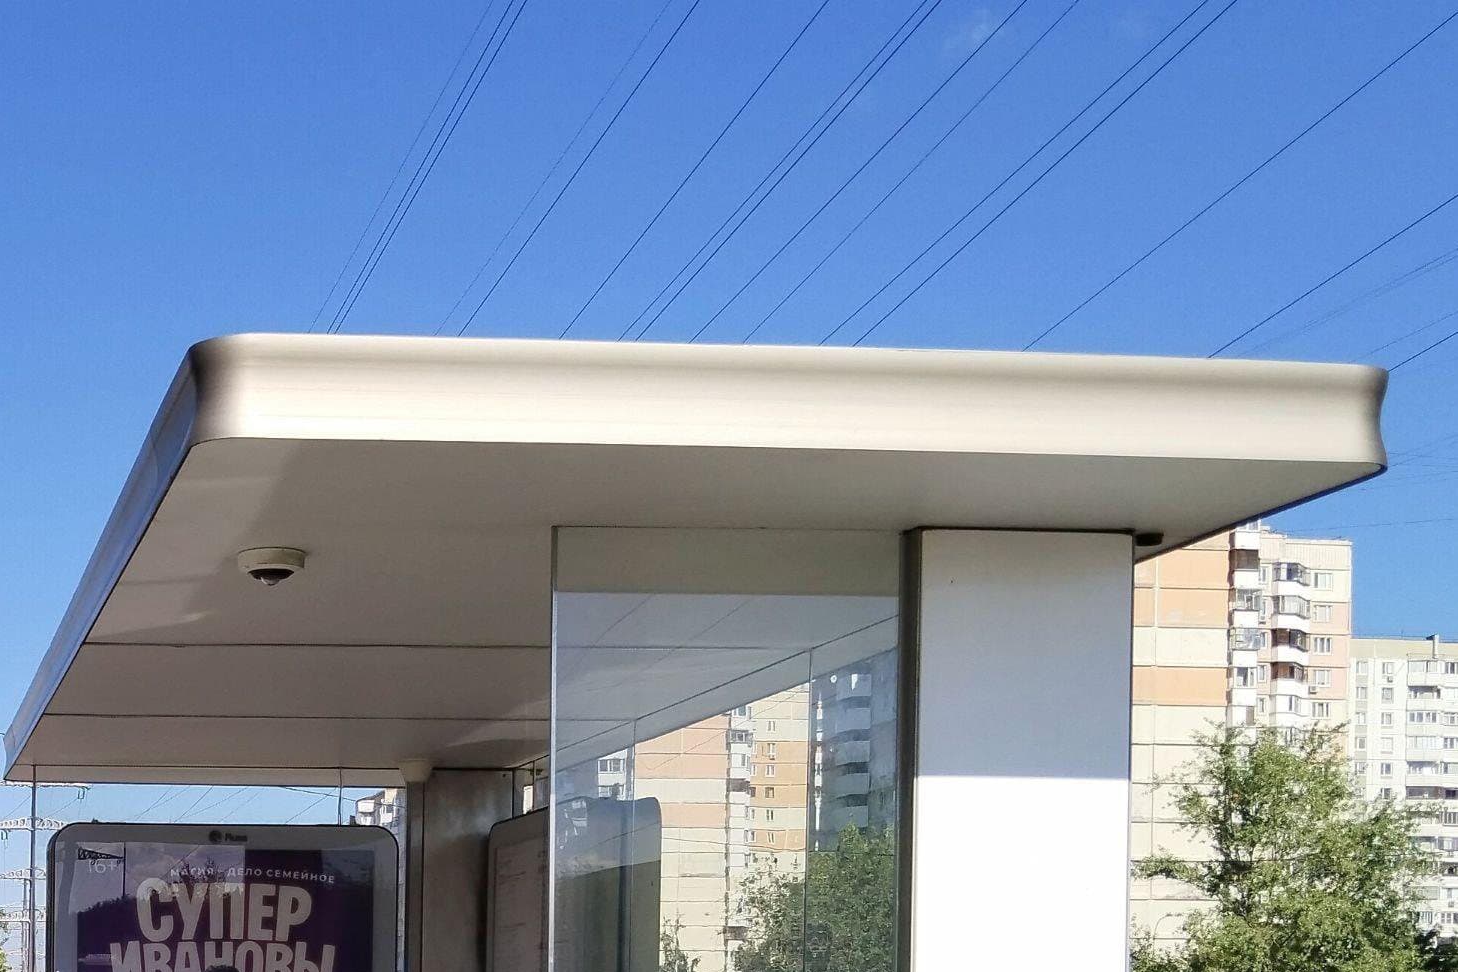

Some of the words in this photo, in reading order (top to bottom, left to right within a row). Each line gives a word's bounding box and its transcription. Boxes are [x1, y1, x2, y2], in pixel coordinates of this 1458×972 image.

[227, 867, 263, 877] ДЕЛО
[266, 868, 335, 884] СЕМЕЙНОЕ
[136, 877, 312, 942] СУПЕР
